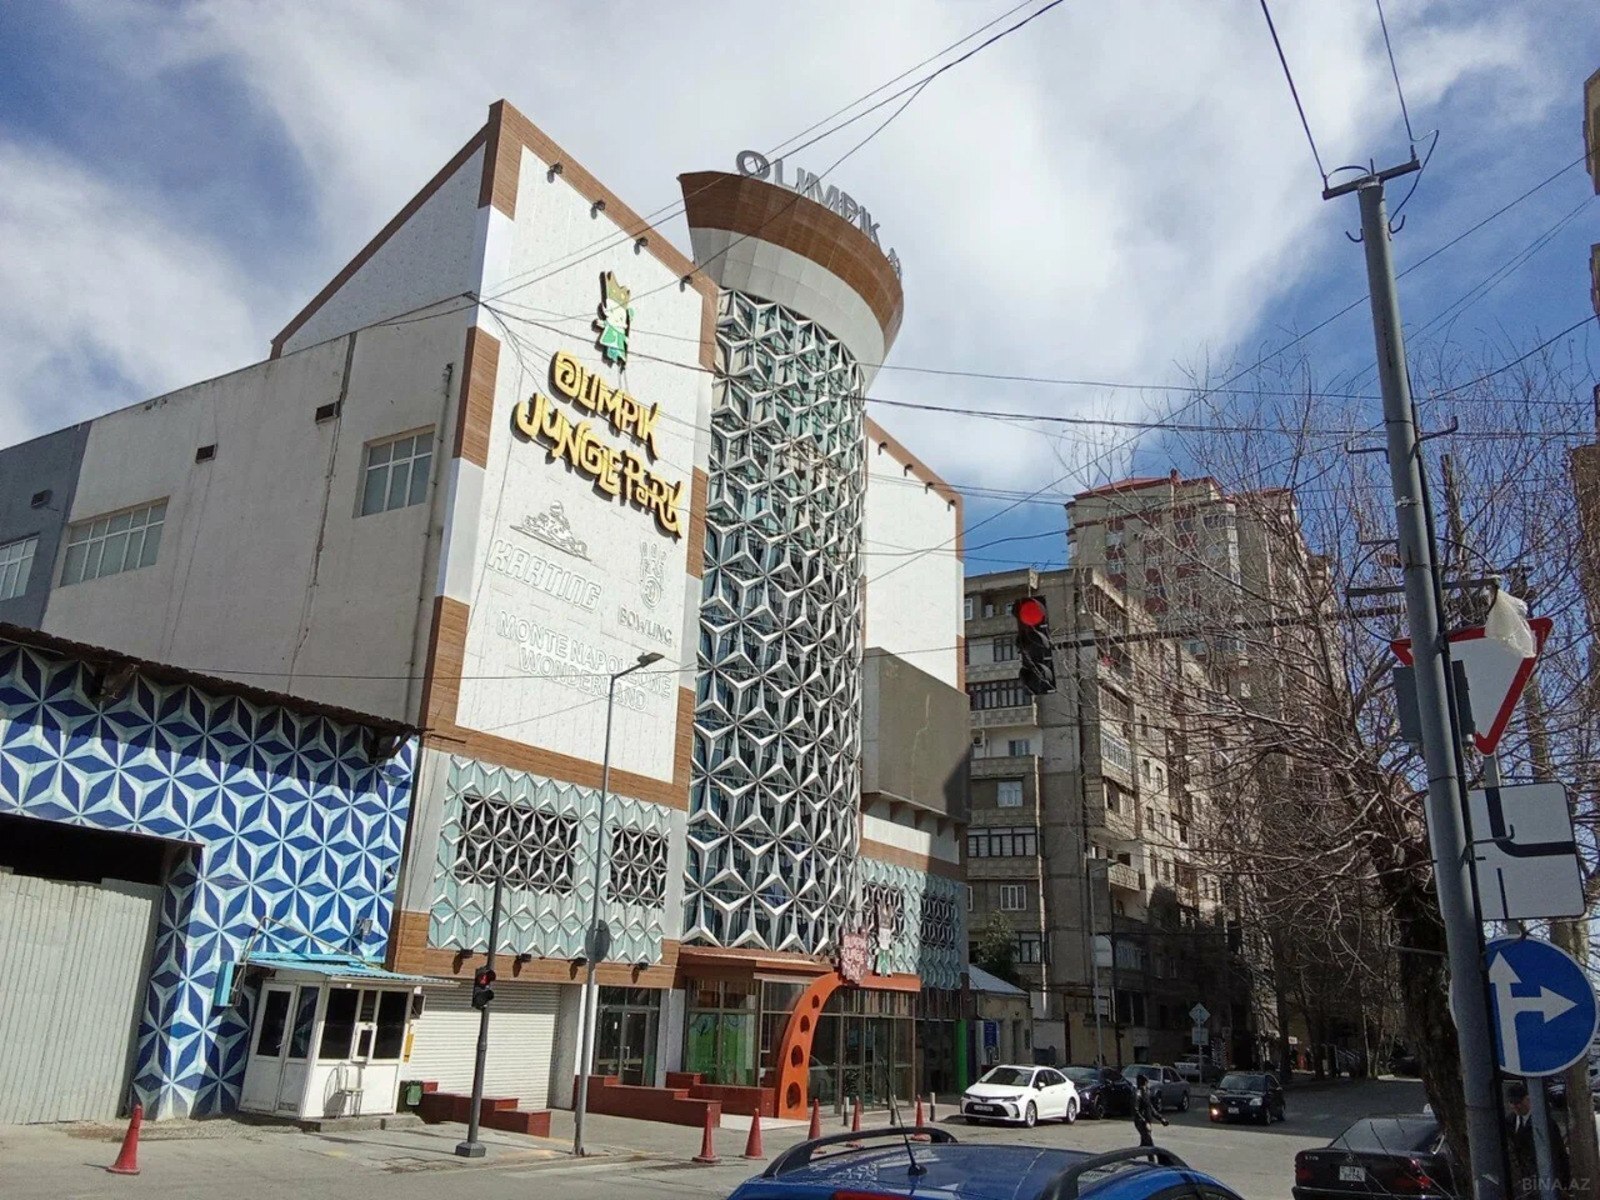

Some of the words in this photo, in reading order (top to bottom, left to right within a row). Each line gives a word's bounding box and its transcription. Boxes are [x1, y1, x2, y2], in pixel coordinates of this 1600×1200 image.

[736, 150, 881, 251] OLIMPIK
[552, 351, 660, 460] OLIMPIK
[486, 540, 602, 614] KARTING
[618, 606, 673, 645] BOWLING
[519, 648, 648, 711] WONDERLAND
